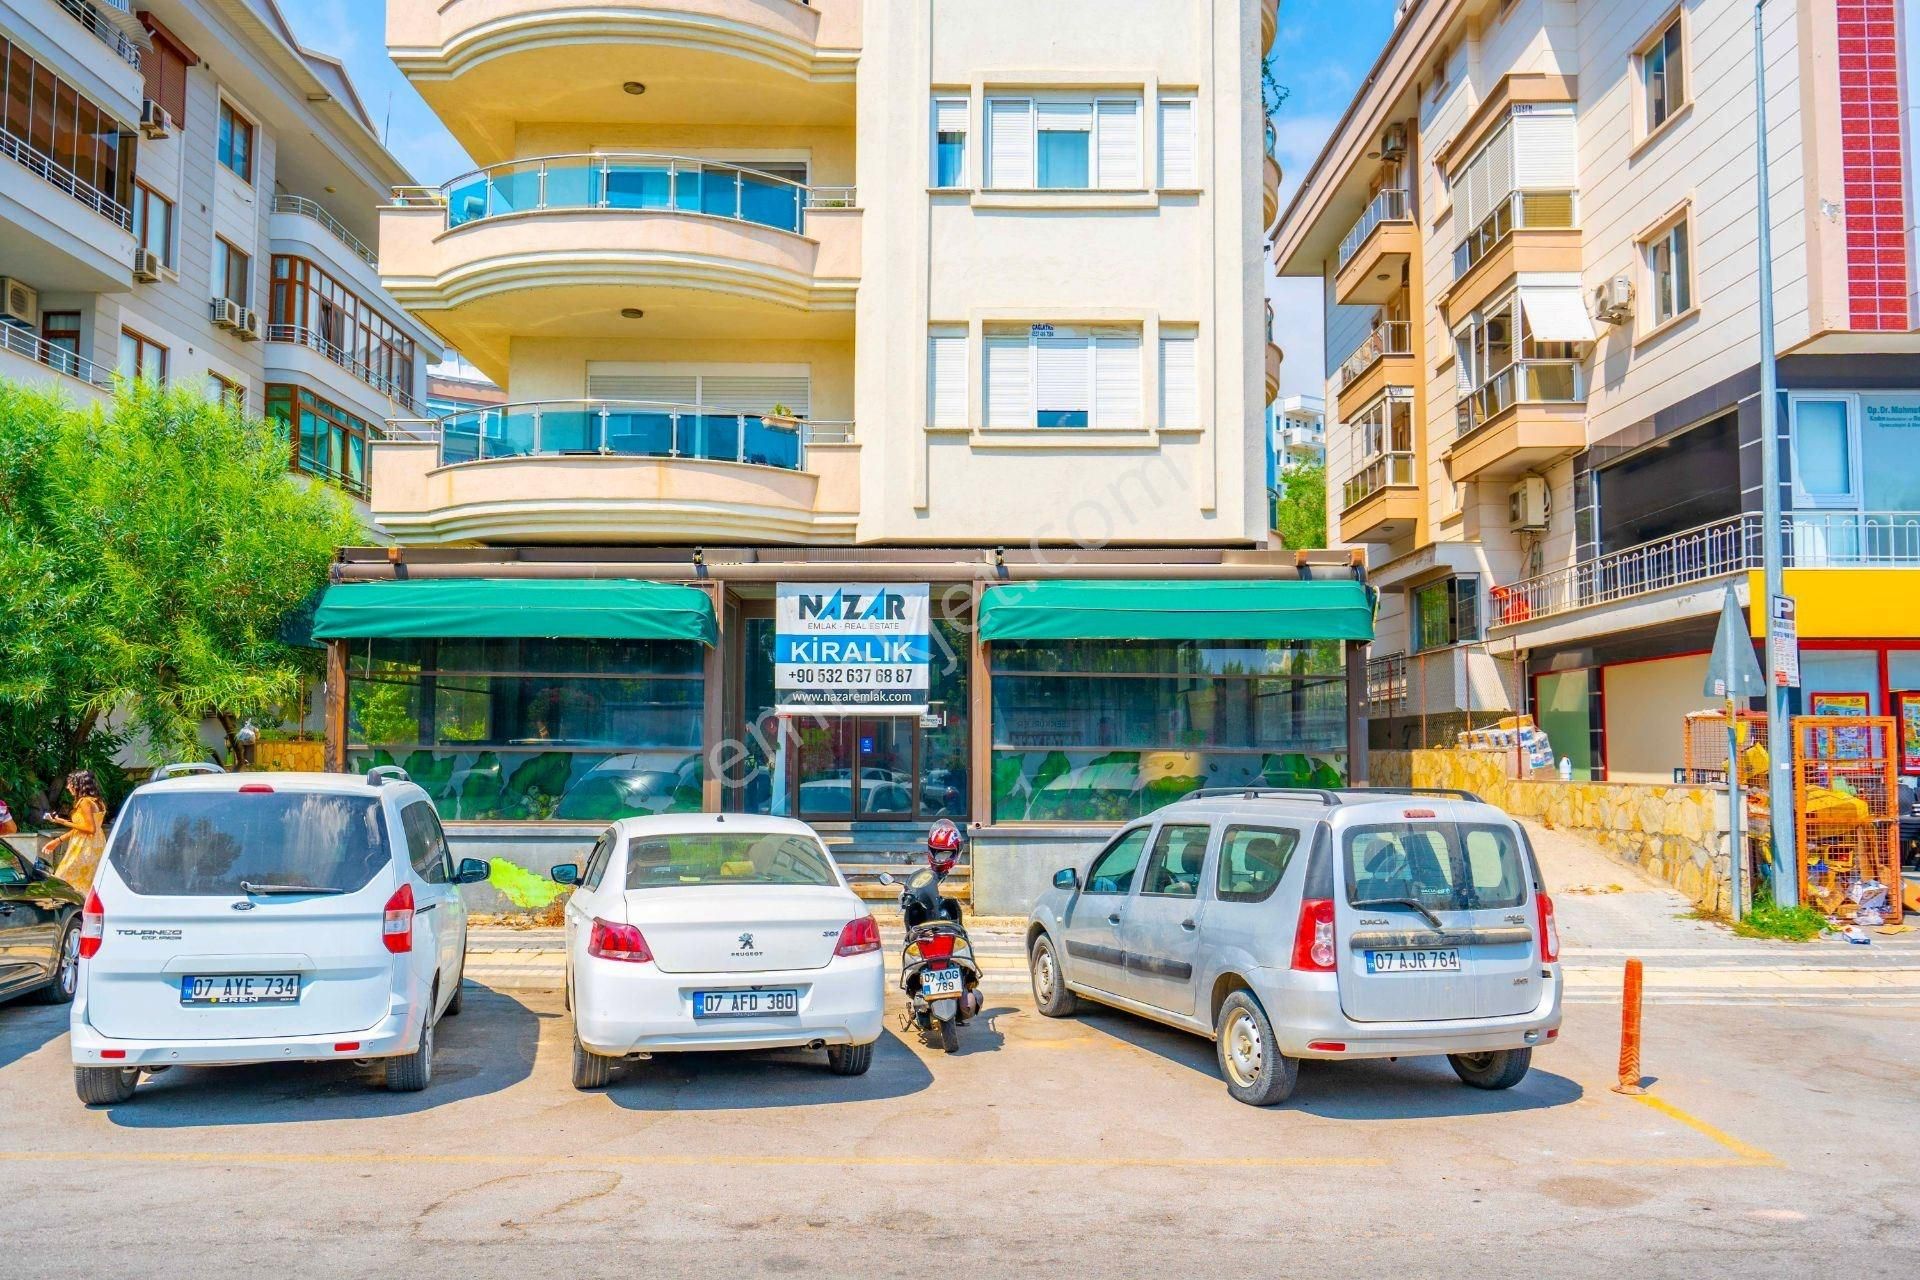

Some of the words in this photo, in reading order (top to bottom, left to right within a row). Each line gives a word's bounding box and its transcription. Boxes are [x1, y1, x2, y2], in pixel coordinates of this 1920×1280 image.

[799, 587, 906, 620] NAZAR
[1774, 597, 1794, 618] P
[808, 622, 837, 630] EMLAK
[845, 622, 866, 630] REAL
[869, 622, 900, 630] ESTATE
[791, 637, 913, 662] KİRALIK
[788, 669, 814, 683] +90
[817, 669, 843, 683] 532
[846, 669, 871, 683] 637
[875, 669, 893, 683] 68
[896, 669, 913, 683] 87
[792, 690, 912, 703] www.nazaremlak.com
[1375, 953, 1394, 970] 07
[1399, 952, 1427, 969] AJR
[1431, 951, 1457, 968] 764
[925, 973, 936, 983] 07
[938, 970, 959, 981] AOG
[193, 979, 214, 996] 07
[223, 978, 255, 996] AYE
[264, 977, 295, 996] 734
[936, 981, 954, 992] 789
[705, 995, 723, 1012] 07
[731, 994, 758, 1011] AFD
[767, 993, 794, 1010] 380
